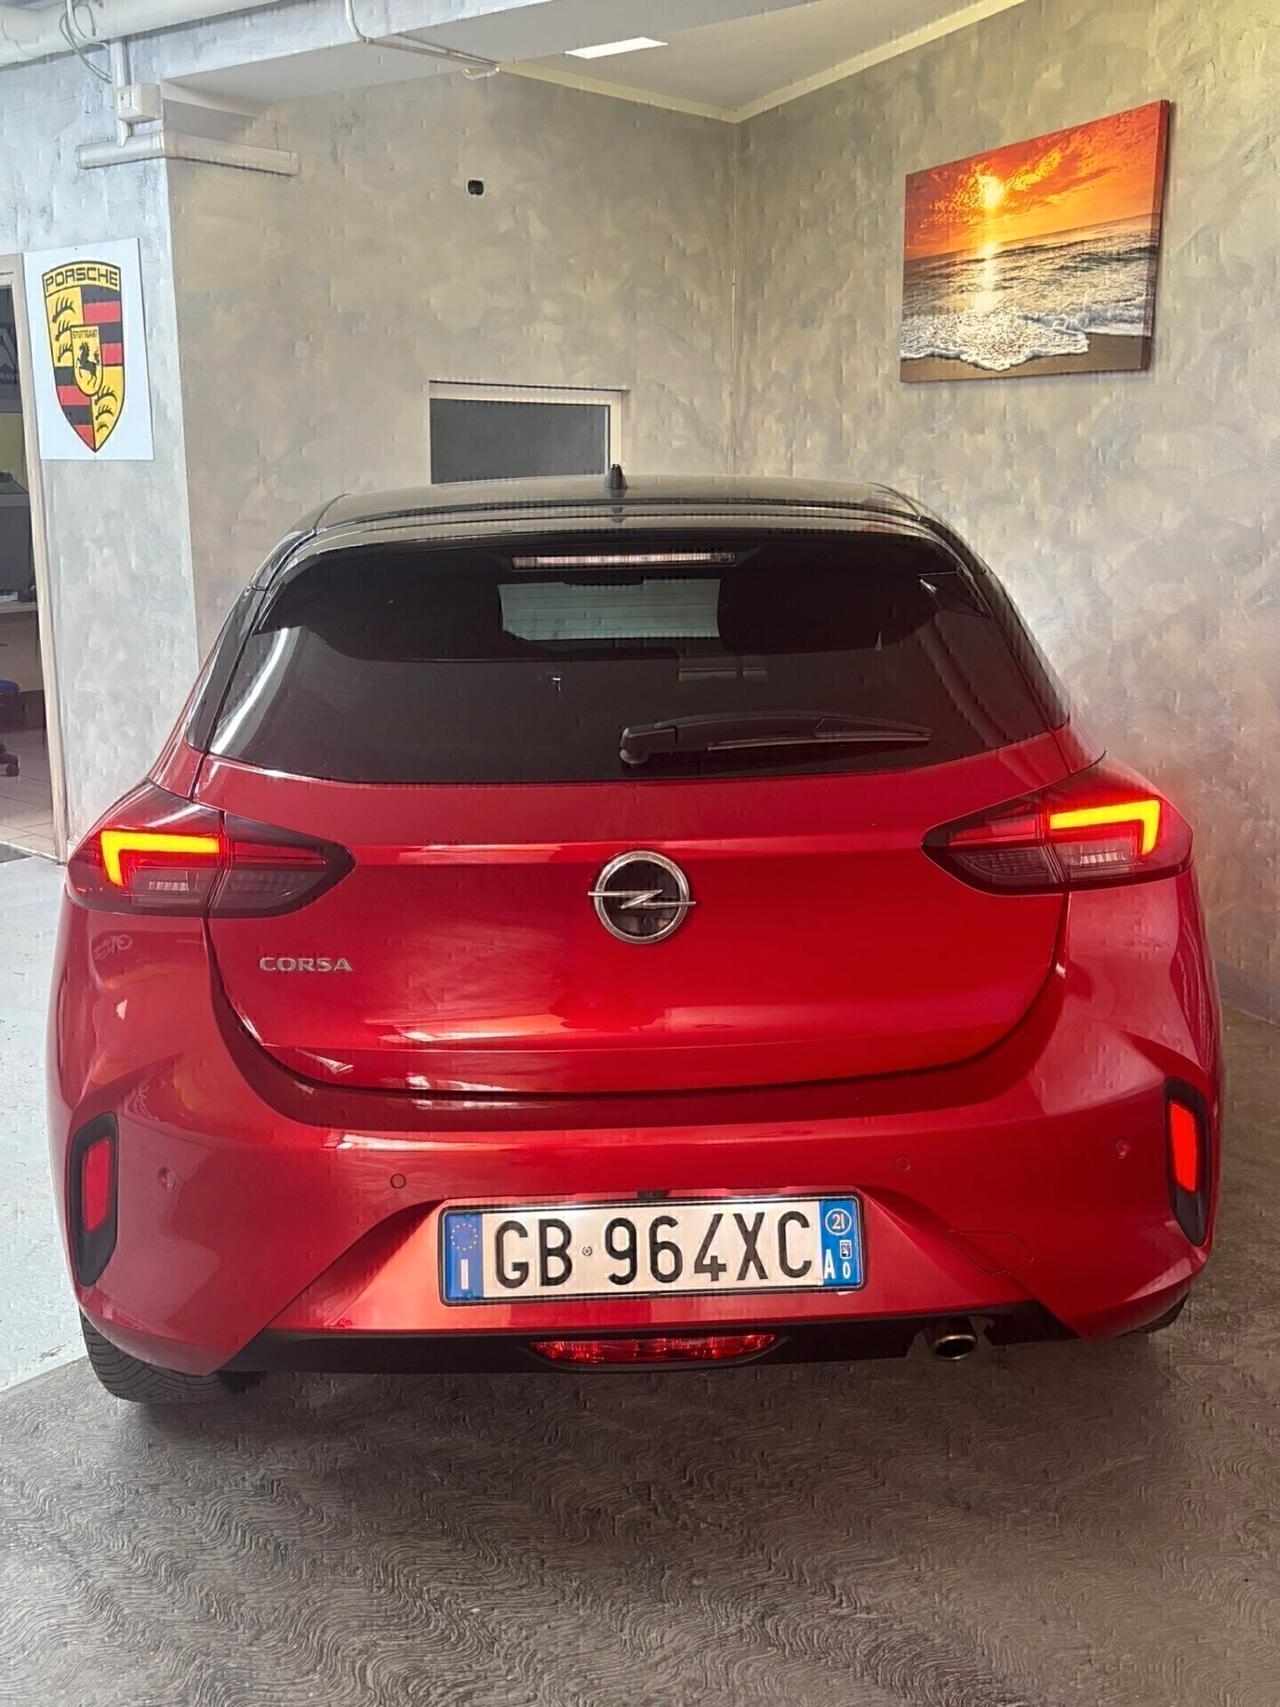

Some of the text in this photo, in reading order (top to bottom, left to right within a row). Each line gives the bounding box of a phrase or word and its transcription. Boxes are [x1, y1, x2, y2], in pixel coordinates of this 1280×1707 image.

[45, 267, 118, 292] PORSCHE
[260, 957, 353, 972] CORSA
[831, 1213, 846, 1230] 21
[494, 1210, 812, 1289] GB 964XC
